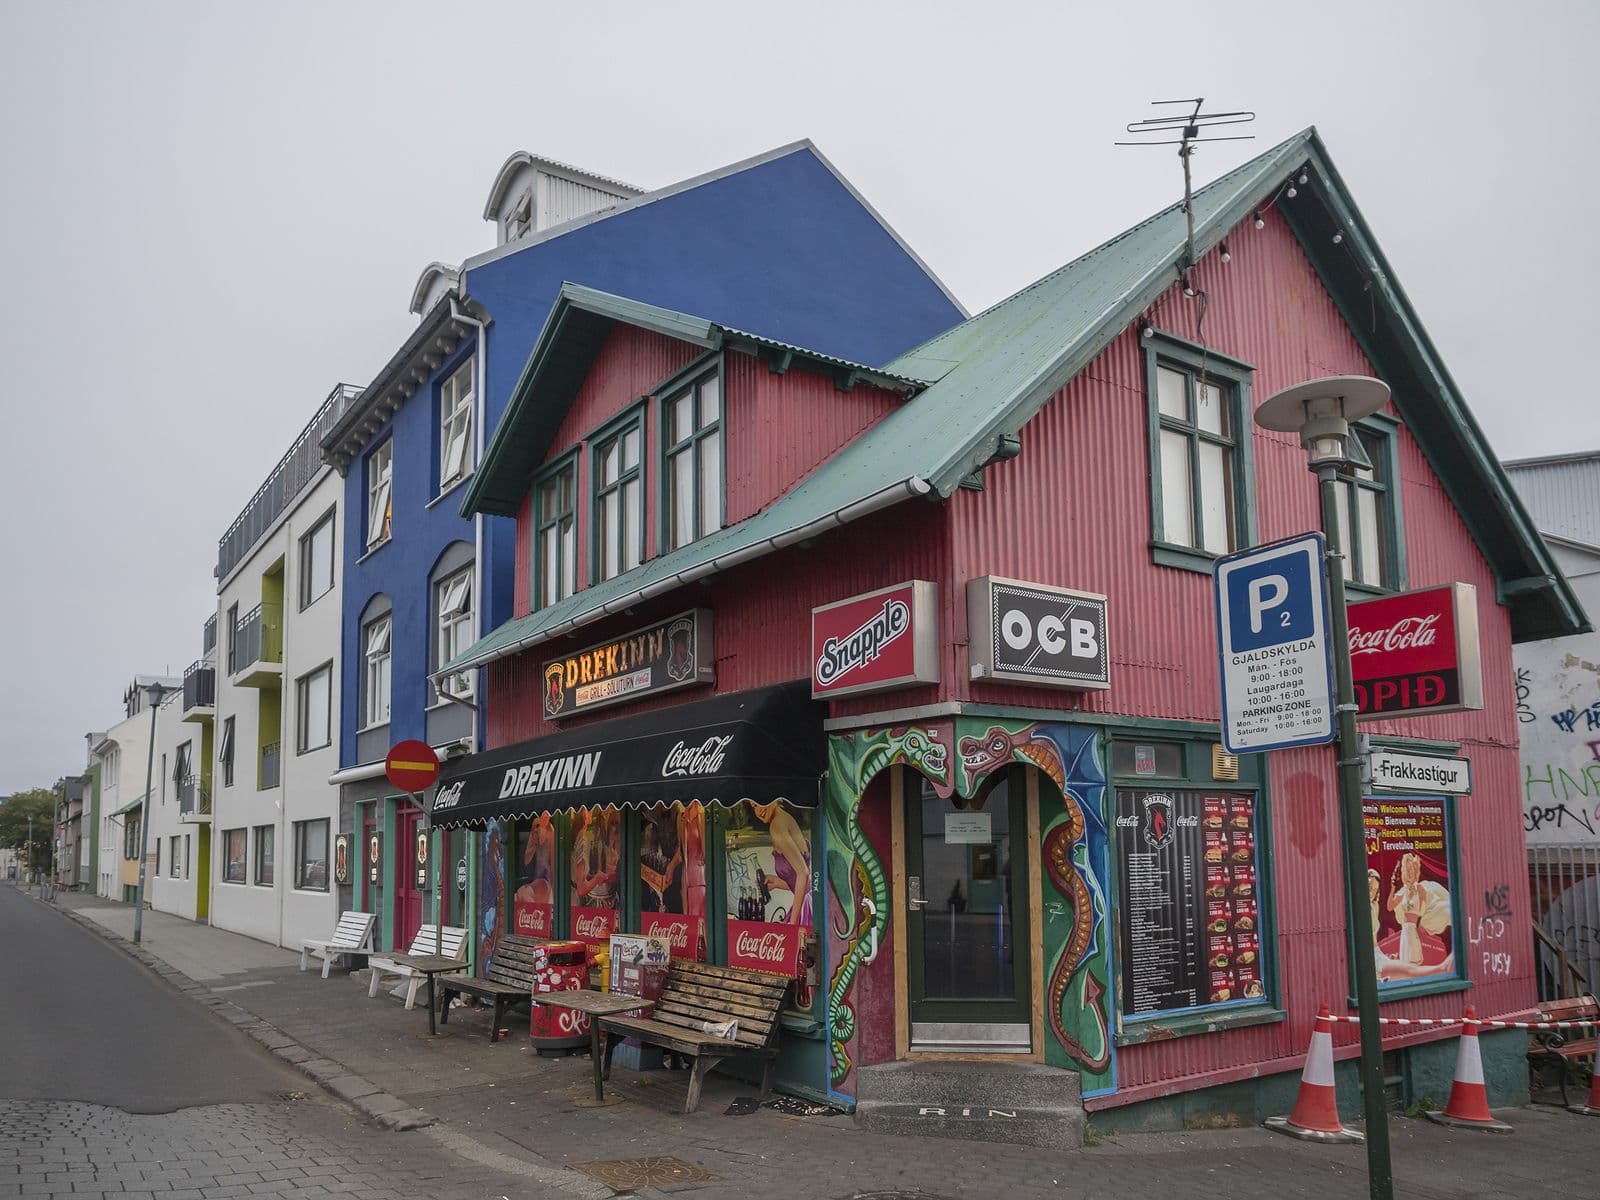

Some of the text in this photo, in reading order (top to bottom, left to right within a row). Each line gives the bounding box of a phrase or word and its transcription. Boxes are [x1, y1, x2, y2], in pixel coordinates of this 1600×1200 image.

[1248, 574, 1289, 634] P
[1280, 611, 1291, 627] 2
[819, 600, 905, 681] Snapple
[1001, 609, 1099, 659] OCB
[565, 628, 665, 688] DREKINN
[1232, 640, 1316, 666] GJALDSKYLDA
[1251, 673, 1270, 683] 9:00
[1279, 666, 1303, 678] 18:00
[1247, 679, 1304, 695] Laugardaga
[1248, 695, 1272, 705] 10:00
[1280, 689, 1305, 700] 16:00
[1242, 700, 1312, 718] PARKING ZONE
[1277, 713, 1294, 721] 9:00
[1237, 726, 1268, 736] Saturday
[1275, 721, 1295, 730] 10:00
[1302, 716, 1322, 726] 16:00
[433, 734, 734, 810] Coca-Cola DREKINN Coca-Cola
[1382, 760, 1458, 786] Frakkastígur
[1380, 804, 1408, 813] Welcome
[1408, 805, 1441, 814] Velkommen
[1385, 816, 1417, 825] Bienvenue
[1407, 828, 1443, 837] Willkommen
[1383, 841, 1414, 850] Tervetuloa
[518, 908, 544, 930] Coca-Cola
[736, 930, 787, 962] Coca-Cola
